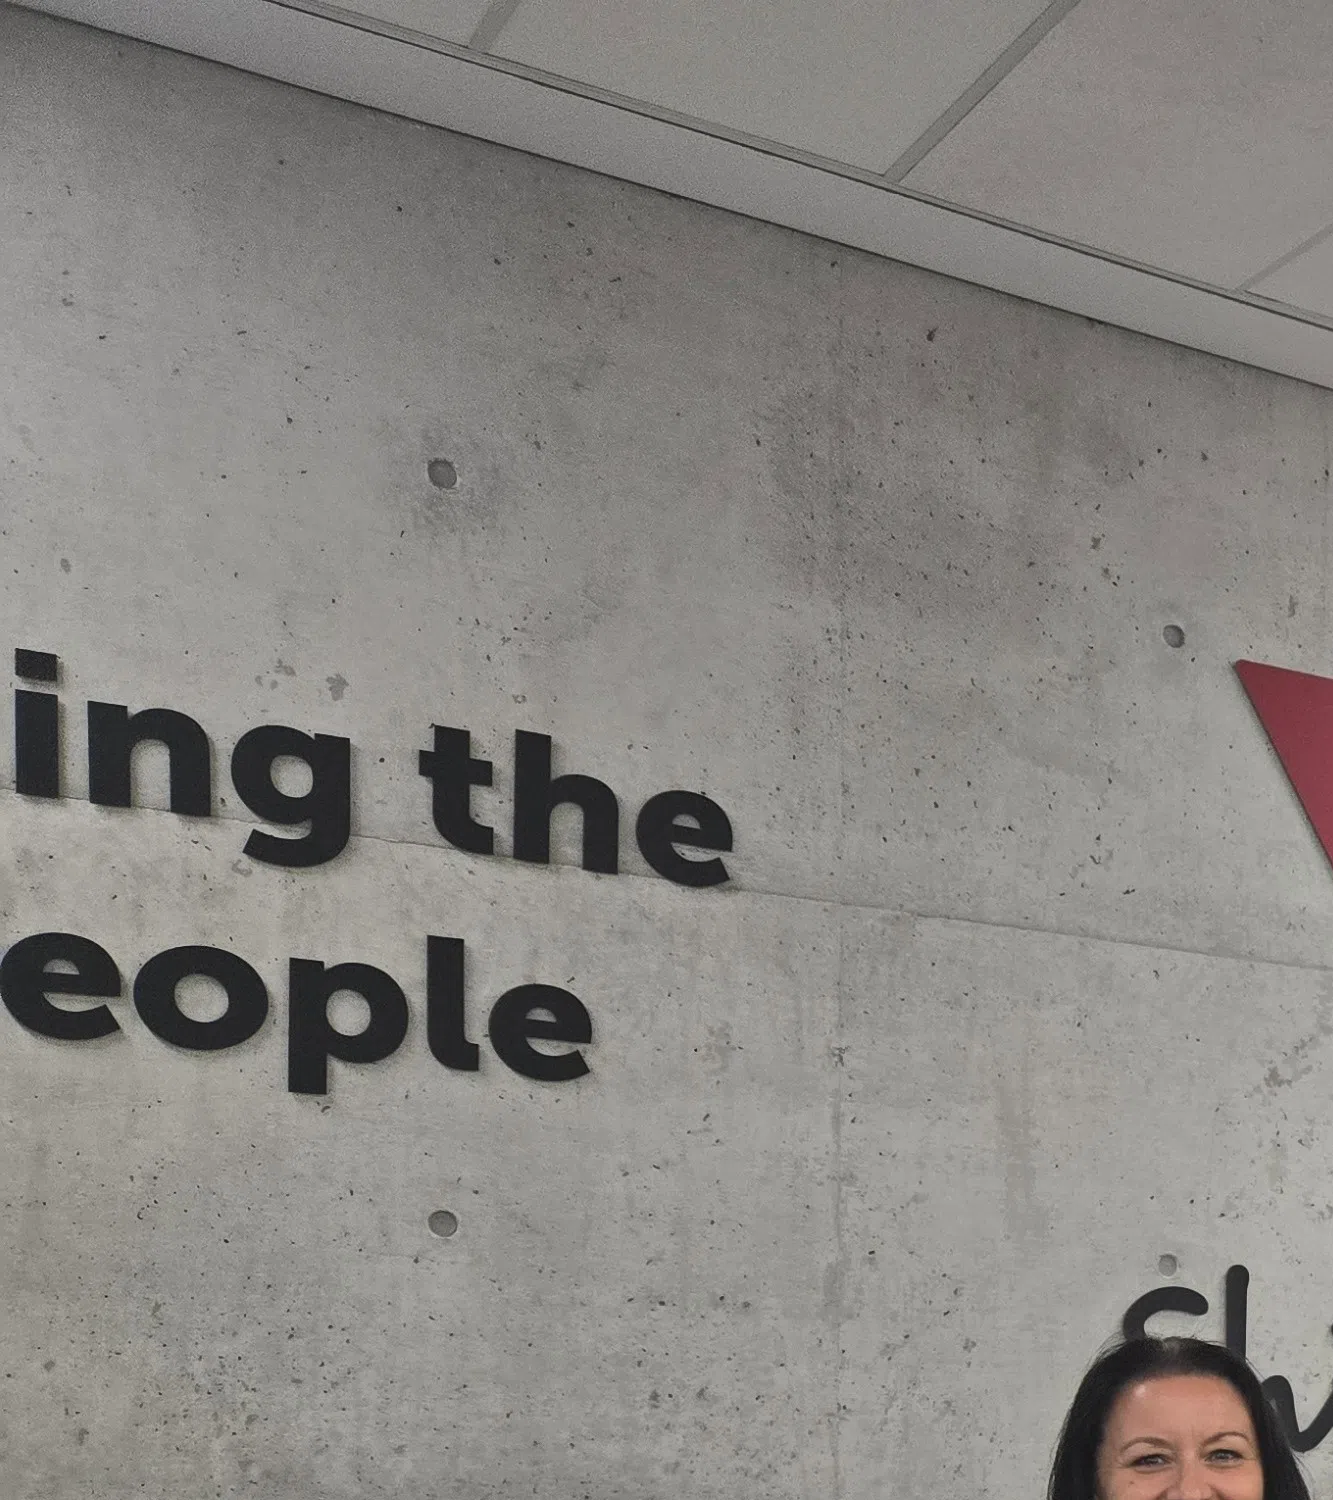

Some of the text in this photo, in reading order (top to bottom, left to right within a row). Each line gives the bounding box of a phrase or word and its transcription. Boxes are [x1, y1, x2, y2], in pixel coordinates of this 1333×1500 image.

[13, 647, 734, 890] ing the
[0, 932, 593, 1096] eople
